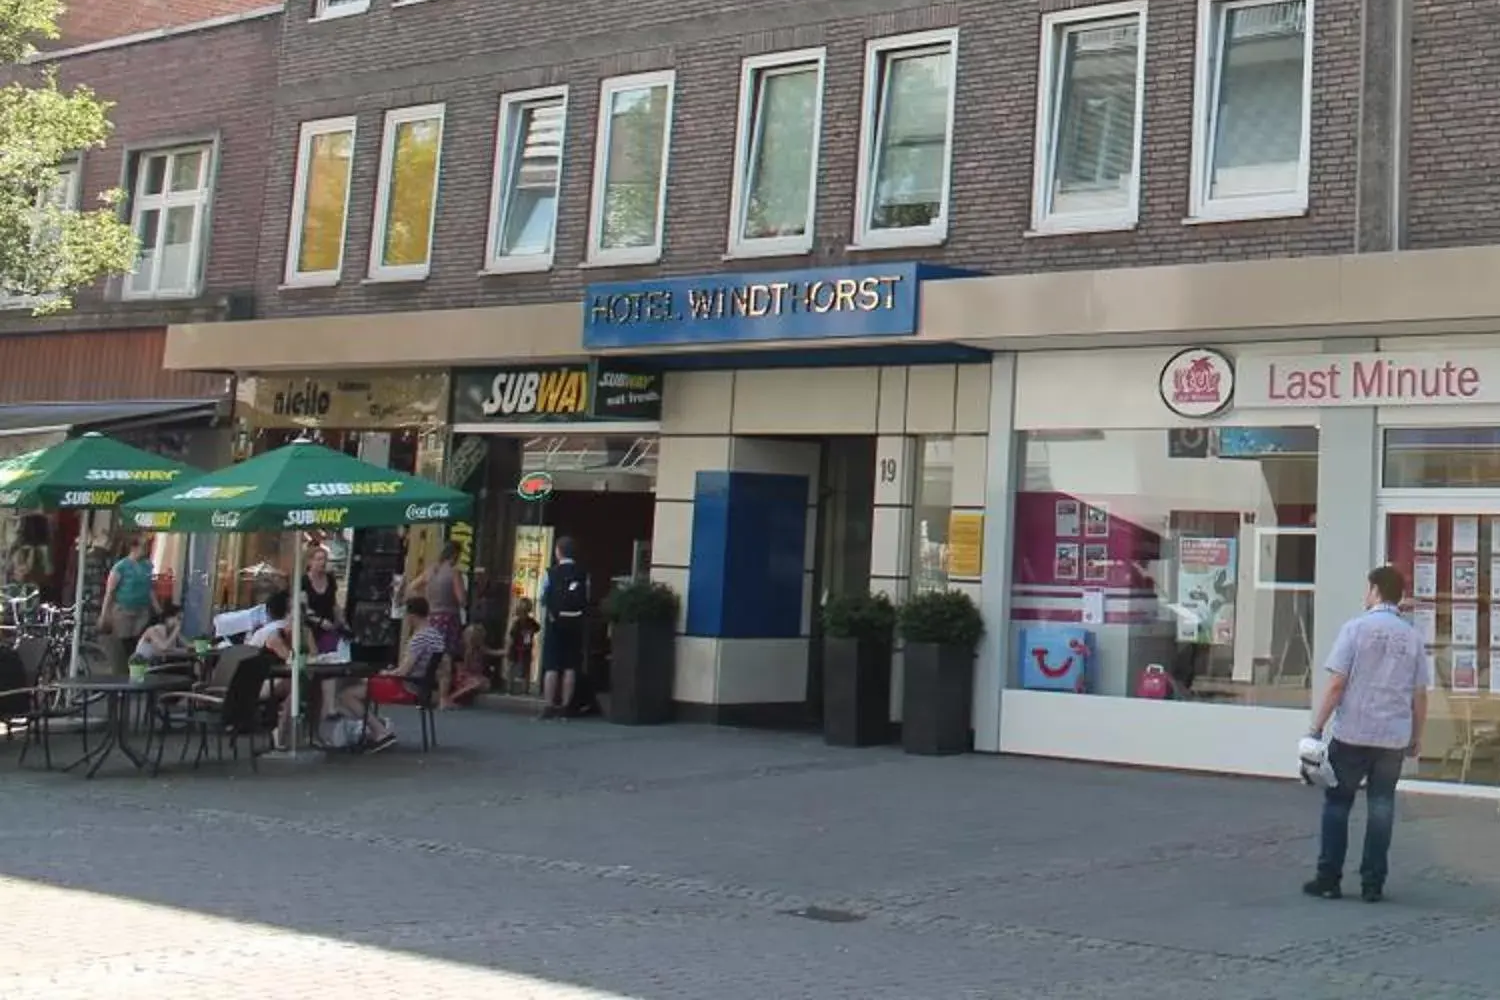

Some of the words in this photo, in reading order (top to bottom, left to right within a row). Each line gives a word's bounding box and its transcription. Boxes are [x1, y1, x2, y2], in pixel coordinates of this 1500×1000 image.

[591, 289, 676, 325] HOTEL
[688, 275, 903, 320] WINDTHORST
[1267, 363, 1342, 399] Last
[1353, 359, 1481, 398] Minute
[880, 458, 897, 483] 19
[61, 490, 124, 505] SUBWAY
[305, 481, 403, 497] SUBWAY
[283, 508, 348, 526] SUBWAY
